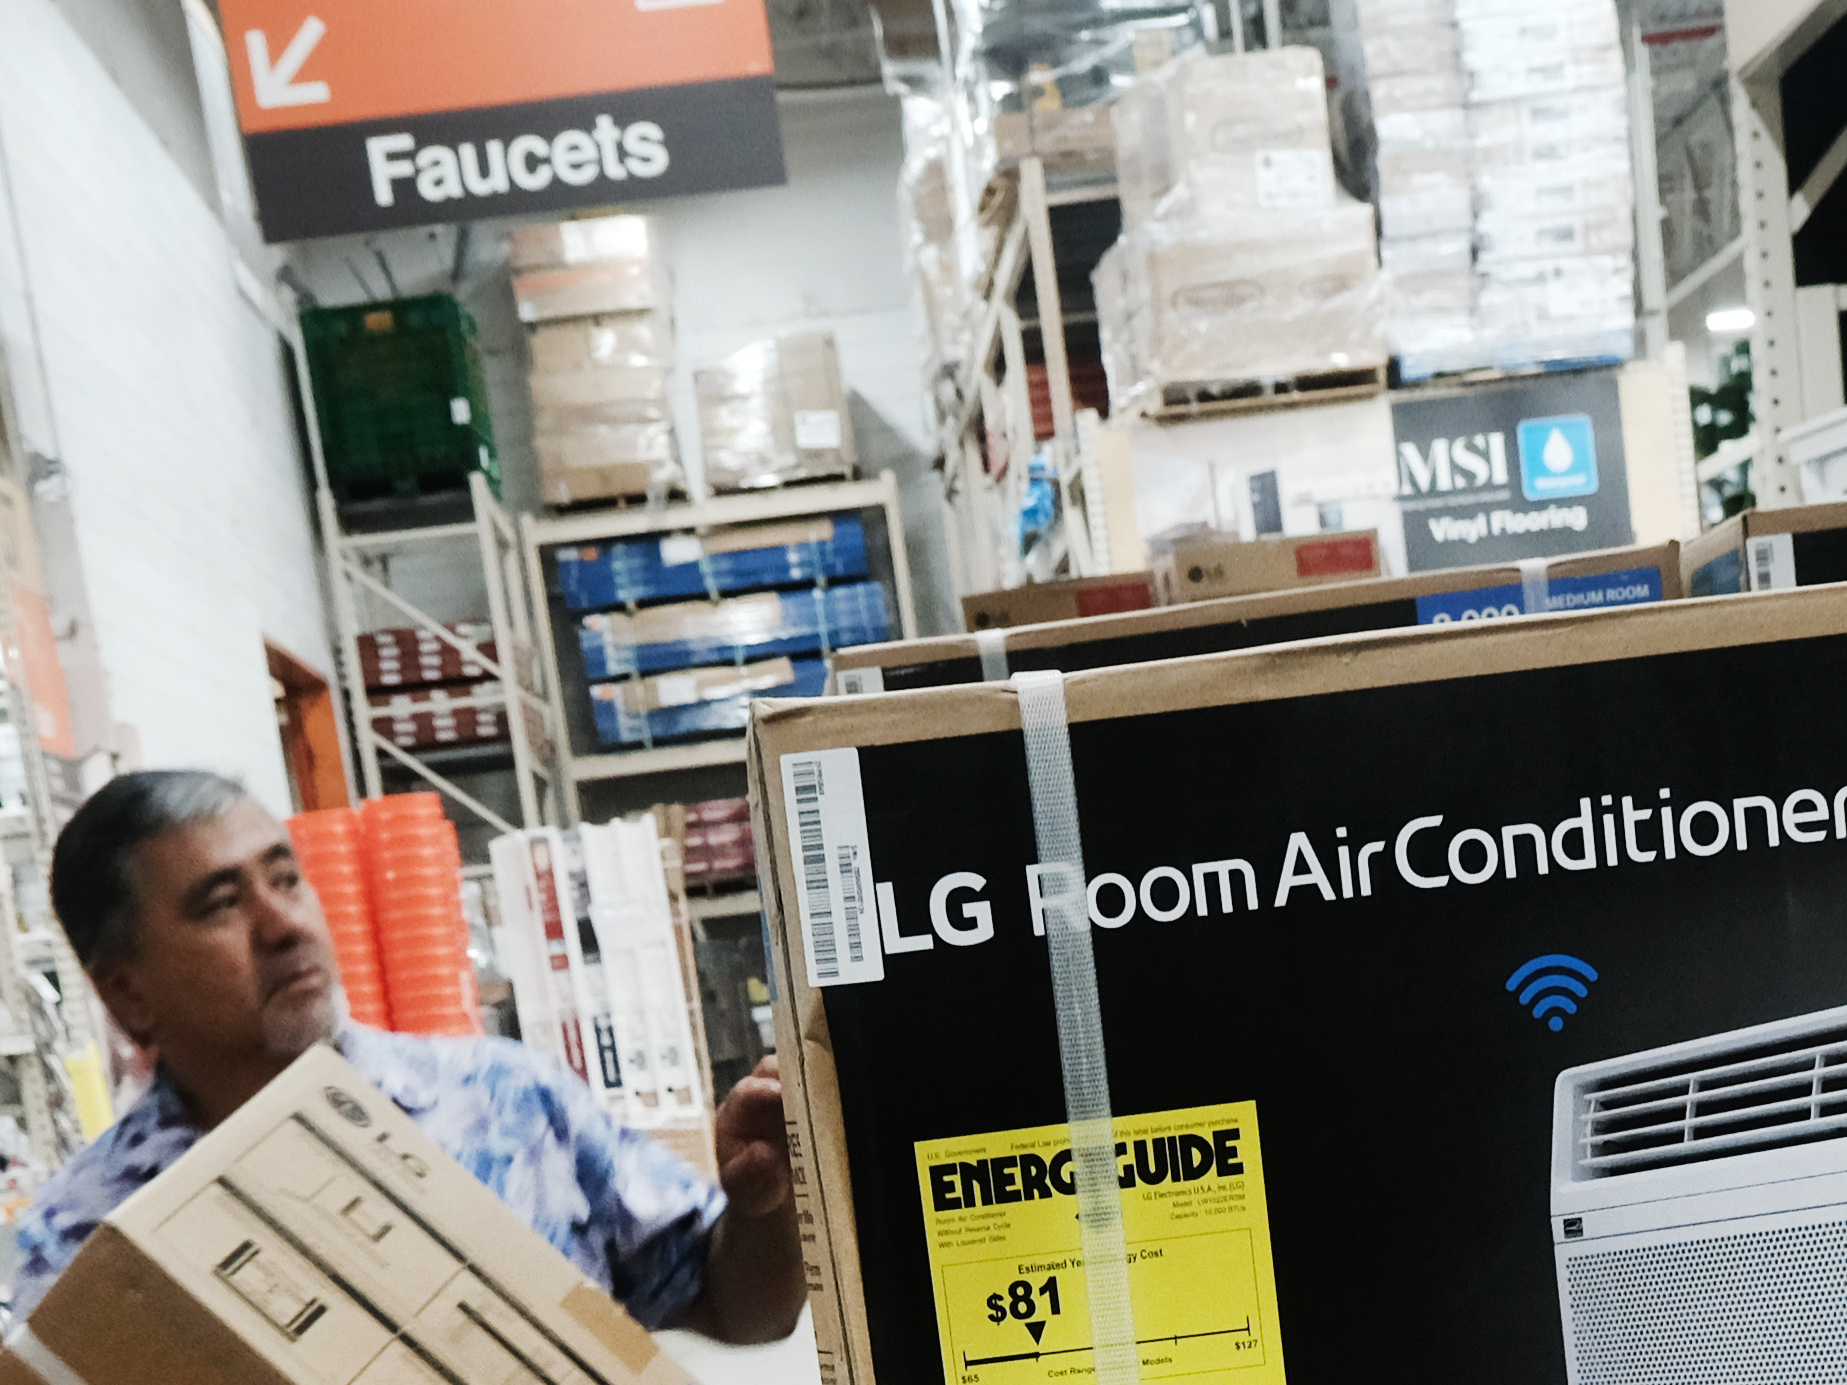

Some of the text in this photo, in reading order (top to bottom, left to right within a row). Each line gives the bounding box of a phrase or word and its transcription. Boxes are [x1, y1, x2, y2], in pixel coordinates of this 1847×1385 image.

[365, 114, 670, 206] Faucets
[1398, 432, 1509, 495] MSI
[1490, 504, 1589, 537] Flooring
[876, 872, 996, 955] LG
[1017, 1258, 1067, 1275] Estimated
[1140, 1248, 1164, 1260] Cost
[986, 1276, 1062, 1325] $81
[1235, 1339, 1259, 1351] $127
